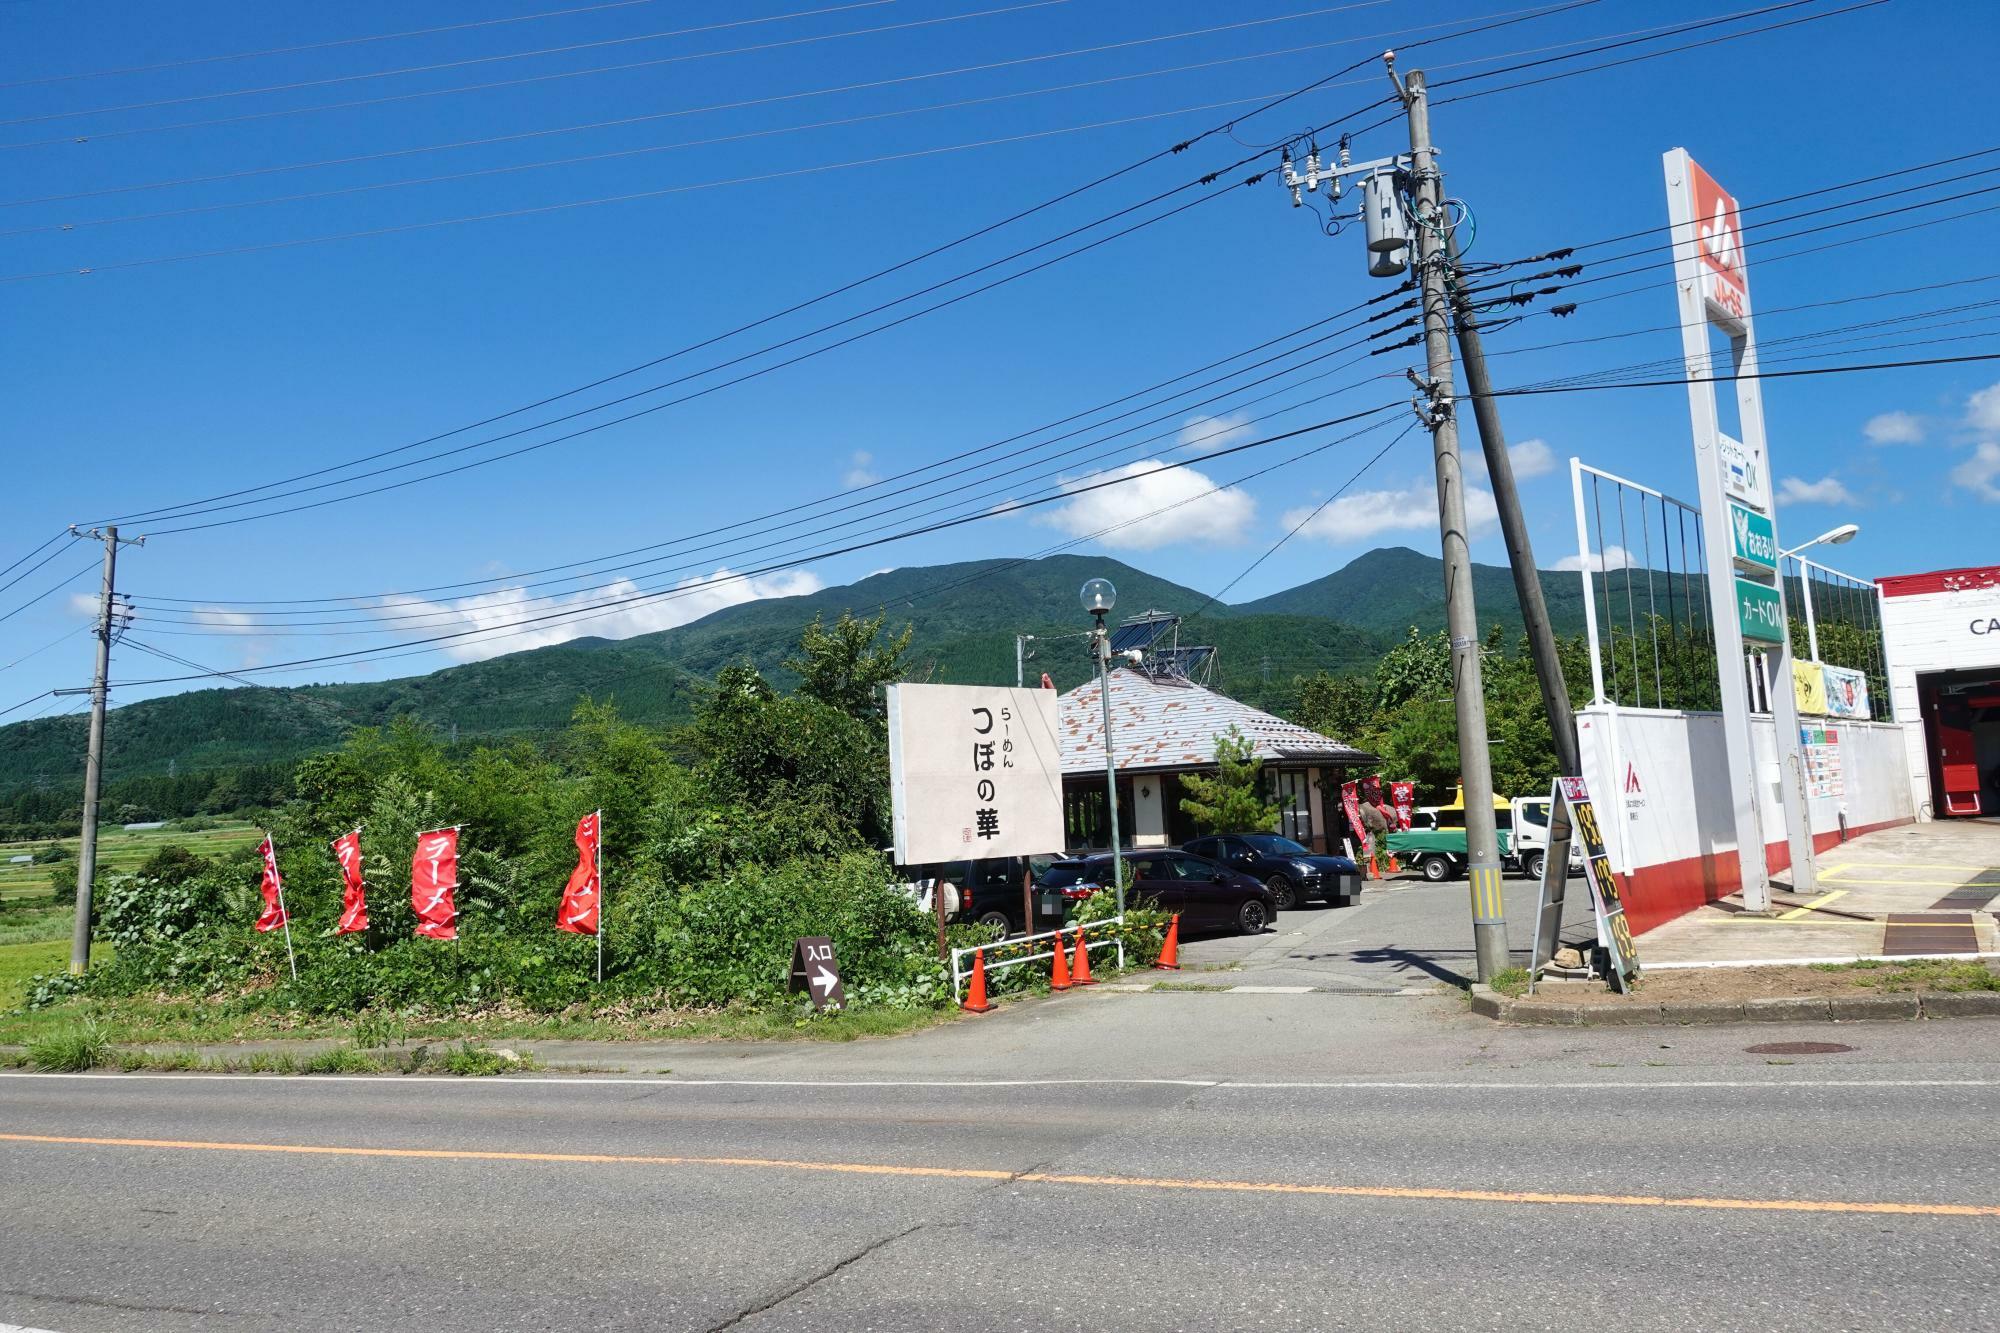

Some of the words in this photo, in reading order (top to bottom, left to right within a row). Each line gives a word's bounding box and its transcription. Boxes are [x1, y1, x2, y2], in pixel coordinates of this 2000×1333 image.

[1748, 531, 1775, 561] おおるり
[1744, 596, 1782, 629] カードOK
[1001, 707, 1014, 769] らーめん
[972, 707, 1000, 840] つぼの華
[807, 945, 832, 961] 入口
